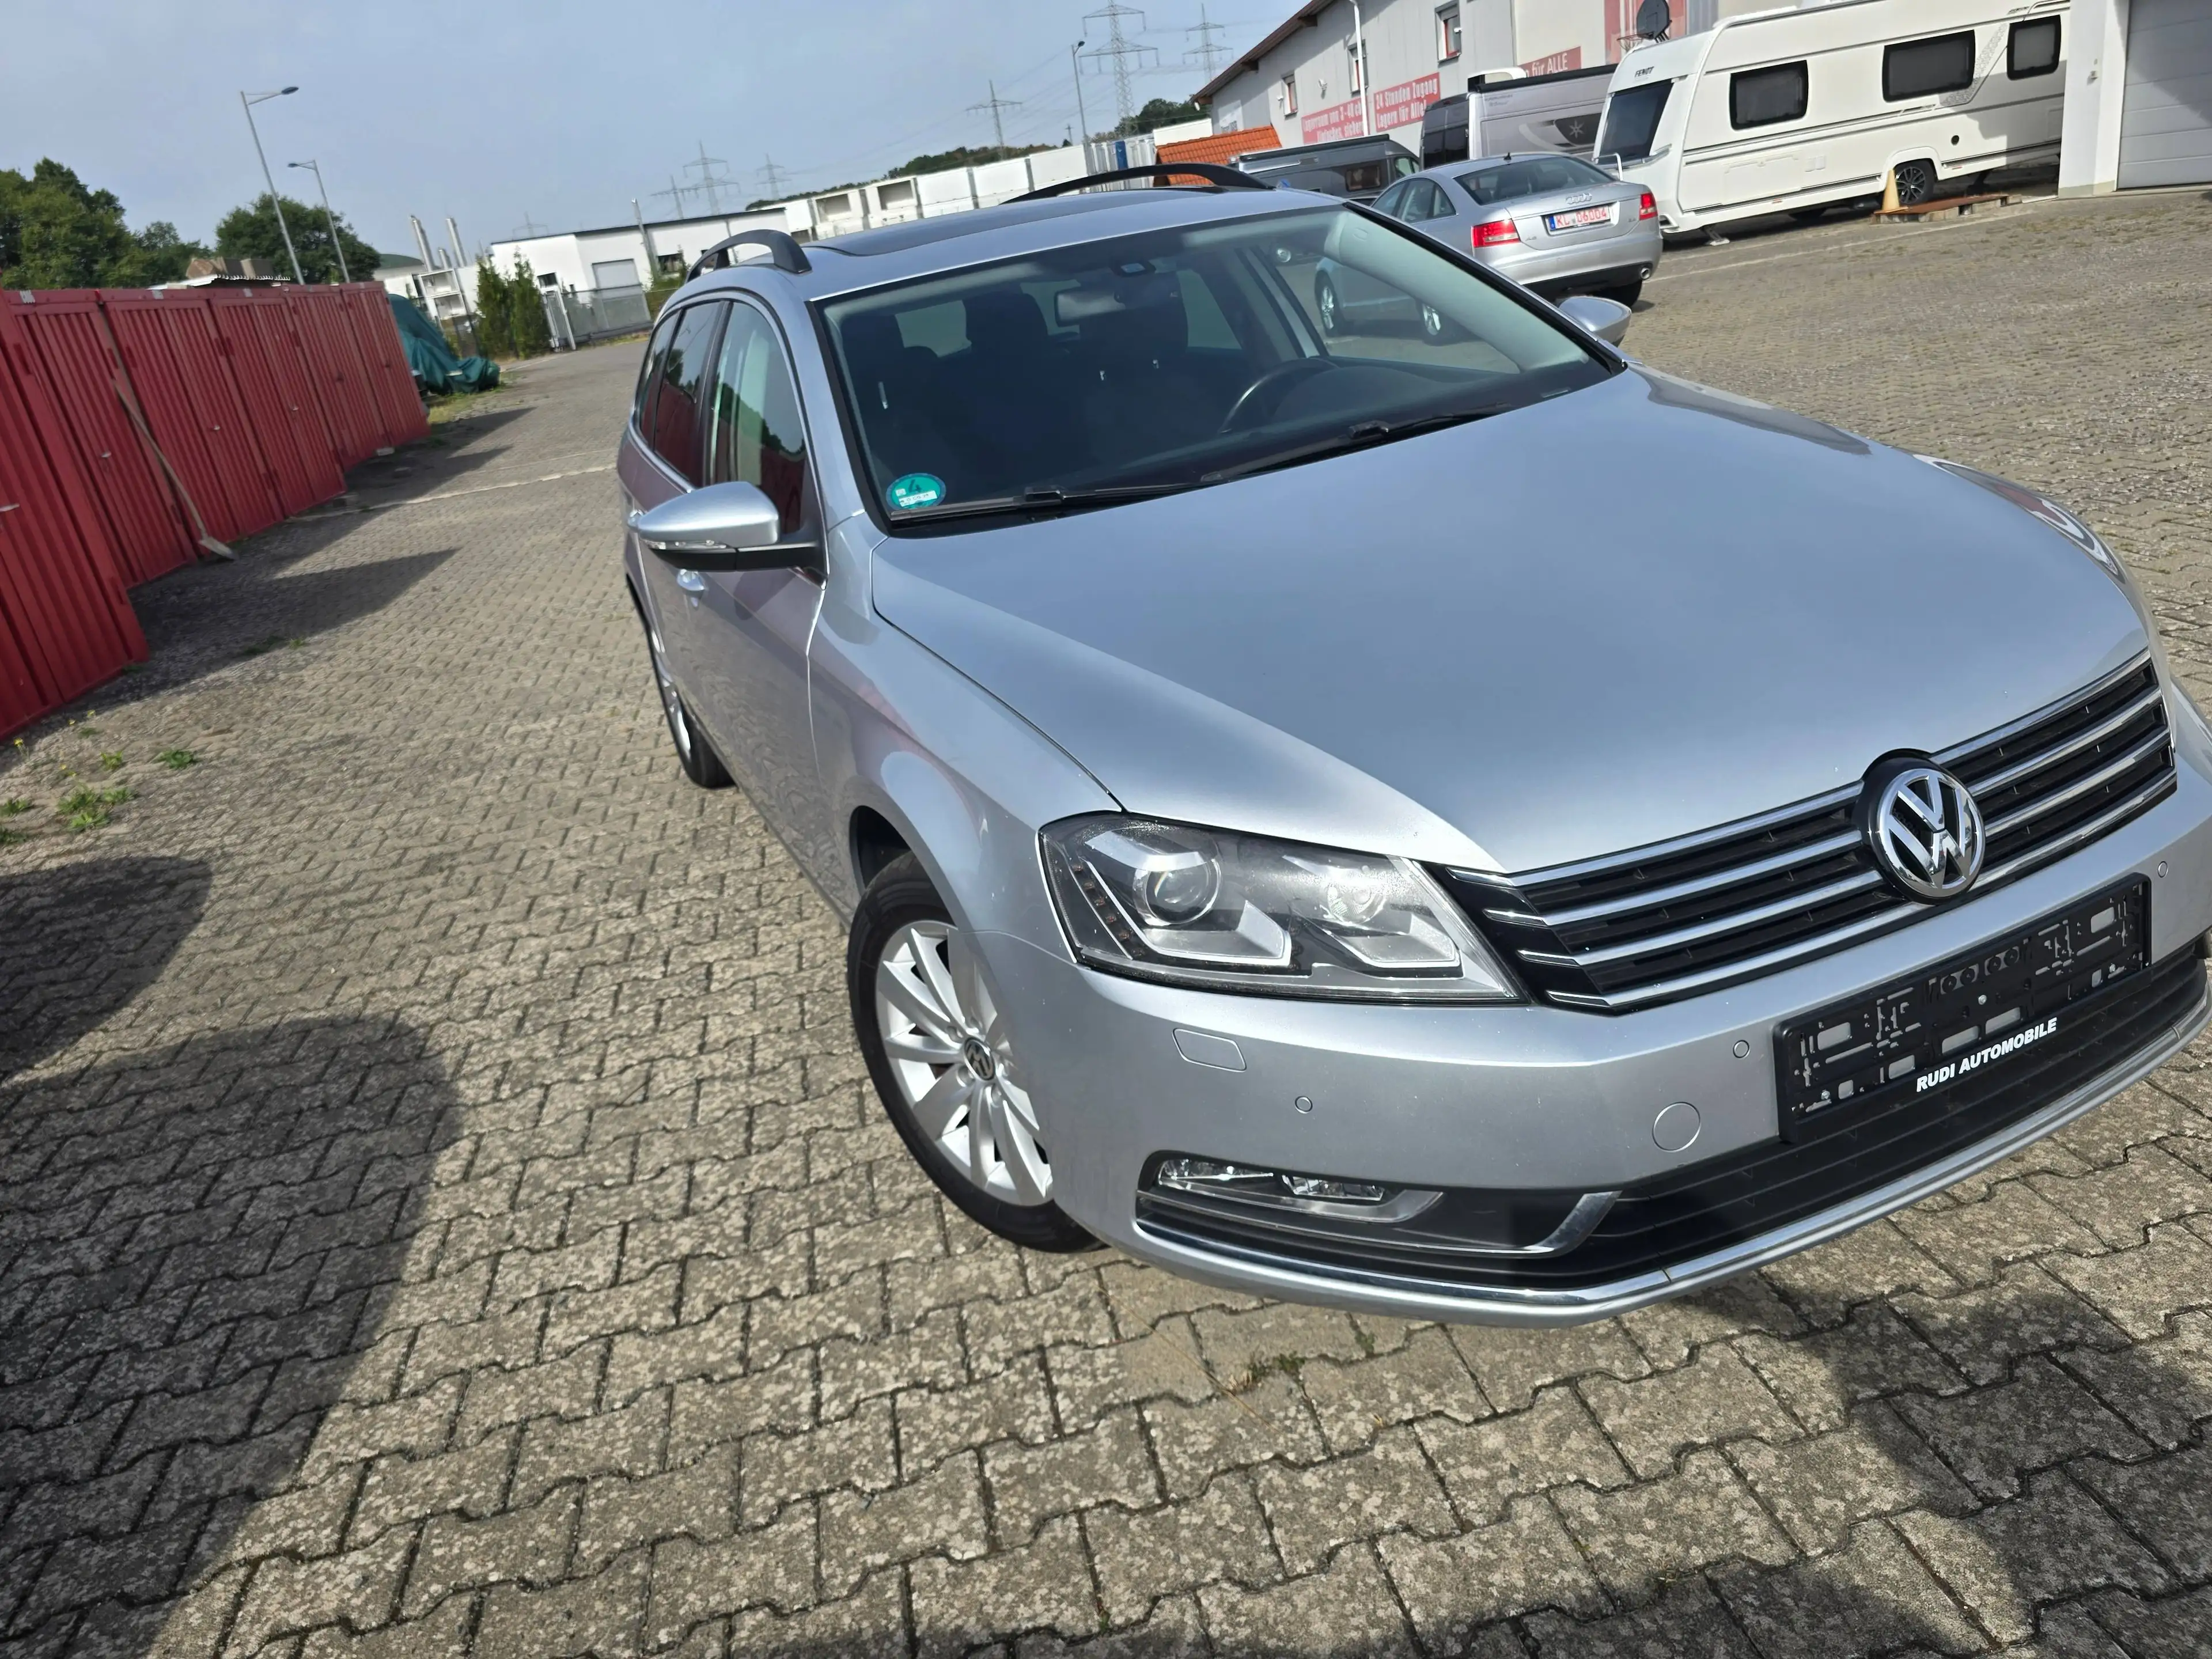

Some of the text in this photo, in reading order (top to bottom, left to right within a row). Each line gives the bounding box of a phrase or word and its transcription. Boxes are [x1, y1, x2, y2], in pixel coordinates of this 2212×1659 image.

[1532, 62, 1545, 77] für
[1547, 53, 1568, 74] ALLE
[1376, 78, 1438, 110] 24 Stunden Zugang
[1377, 111, 1398, 129] Lagern
[1399, 106, 1409, 122] für
[1916, 1017, 2057, 1092] RUDI AUTOMOBILE
